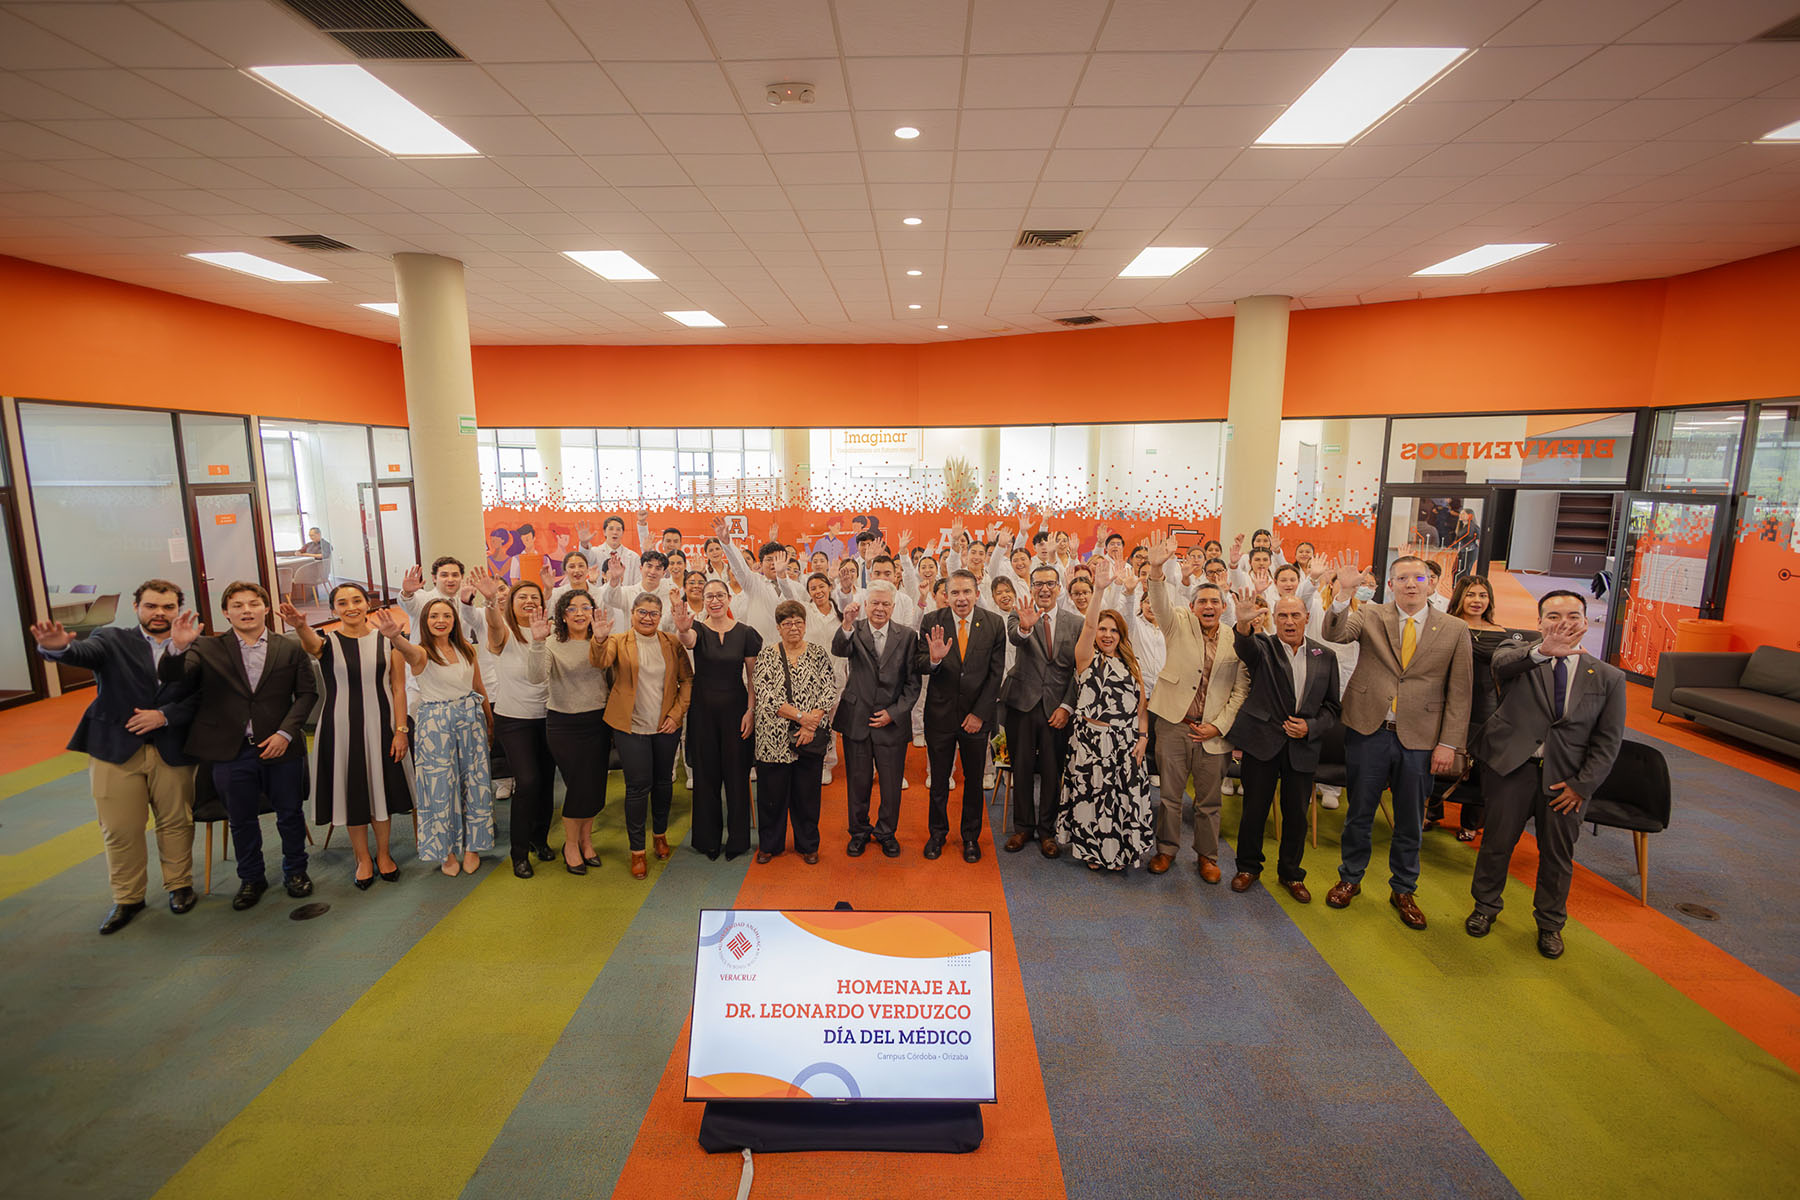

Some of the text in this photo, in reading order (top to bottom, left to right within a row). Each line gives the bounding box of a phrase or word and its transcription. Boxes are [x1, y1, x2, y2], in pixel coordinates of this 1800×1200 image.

[844, 430, 908, 446] Imaginar
[720, 973, 757, 982] VERACRUZ
[836, 979, 971, 996] HOMENAJE AL
[725, 1003, 972, 1020] DR. LEONARDO VERDUZCO
[823, 1026, 972, 1045] DÍA DEL MÉDICO
[877, 1052, 969, 1061] Campus Córdoba Orizaba
